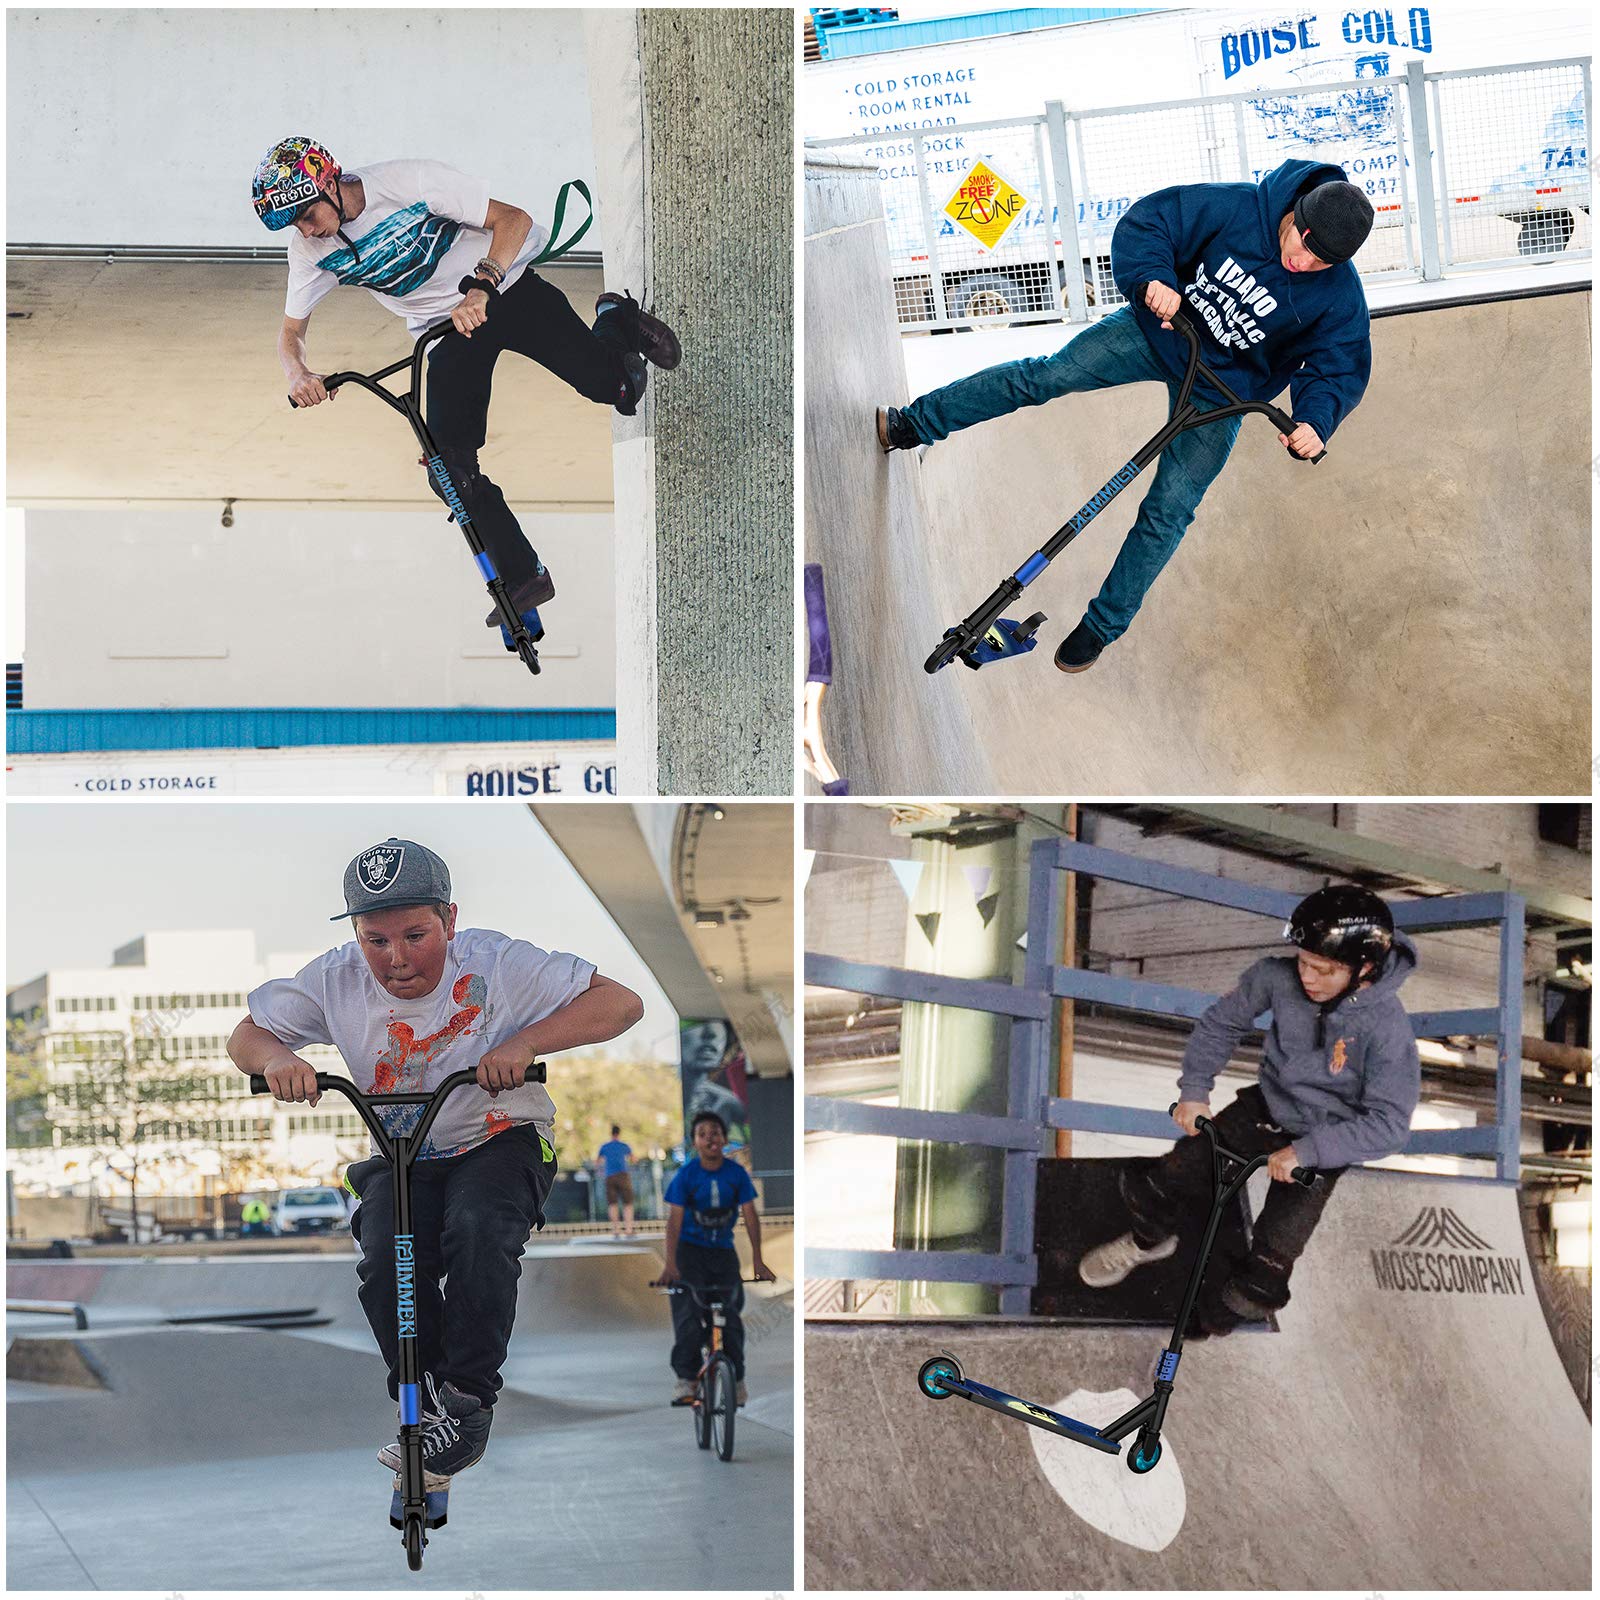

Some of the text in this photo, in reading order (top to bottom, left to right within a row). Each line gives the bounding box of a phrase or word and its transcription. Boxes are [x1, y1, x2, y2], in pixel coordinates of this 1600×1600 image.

[1220, 8, 1433, 80] BOISE COLD
[854, 68, 976, 96] COLD STORAGE
[859, 91, 972, 117] ROOM RENTAL
[879, 165, 918, 180] OCAL
[273, 184, 314, 208] PROTO
[960, 184, 995, 200] FREE
[955, 193, 1021, 224] ZONE
[85, 776, 217, 791] COLD STORAGE
[465, 760, 562, 796] BOISE
[362, 848, 398, 860] RAIDERS
[1370, 1248, 1525, 1295] MOSESCOMPANY
